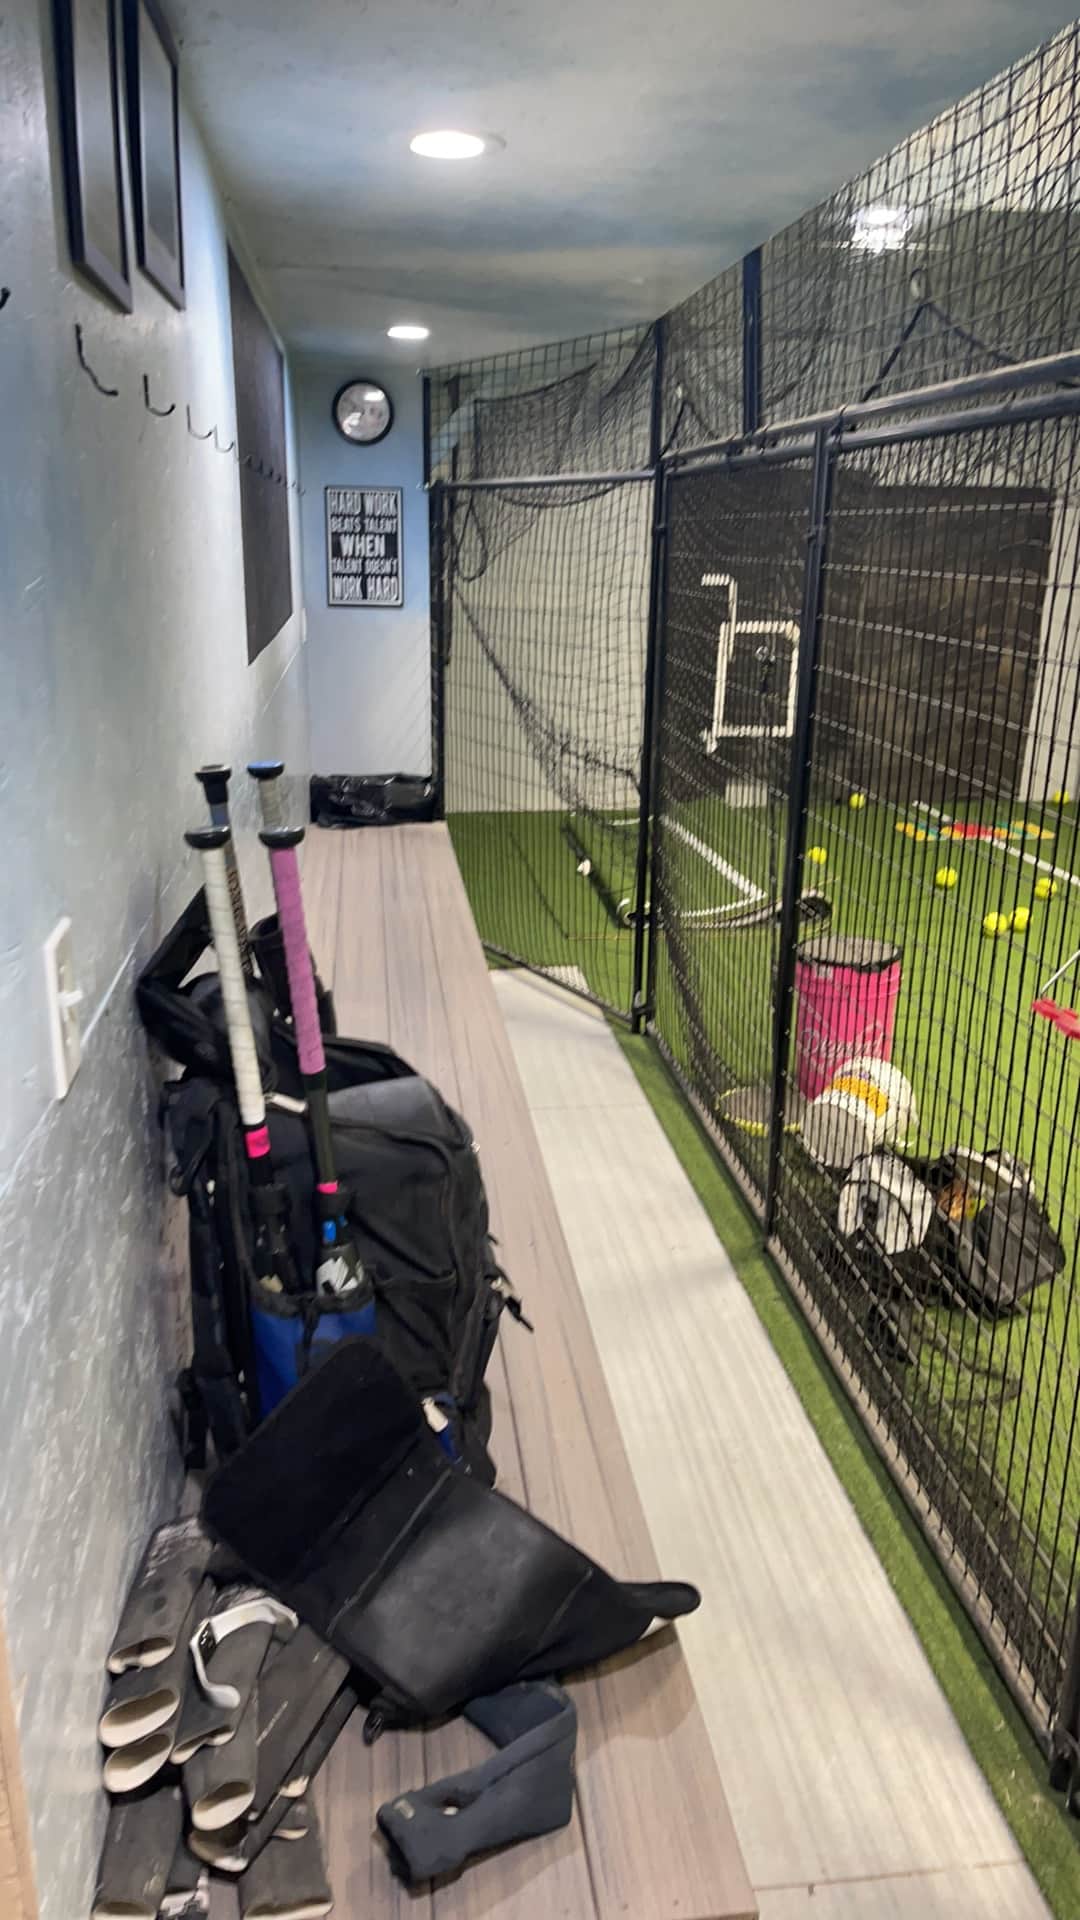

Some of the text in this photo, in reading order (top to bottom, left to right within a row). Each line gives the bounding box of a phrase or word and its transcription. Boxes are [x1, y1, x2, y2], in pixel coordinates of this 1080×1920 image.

[330, 493, 397, 516] HARD WORK
[331, 516, 397, 534] BEATS TALENT
[340, 534, 386, 558] WHEN
[332, 558, 363, 574] TALENT
[333, 575, 399, 601] WORK HARD
